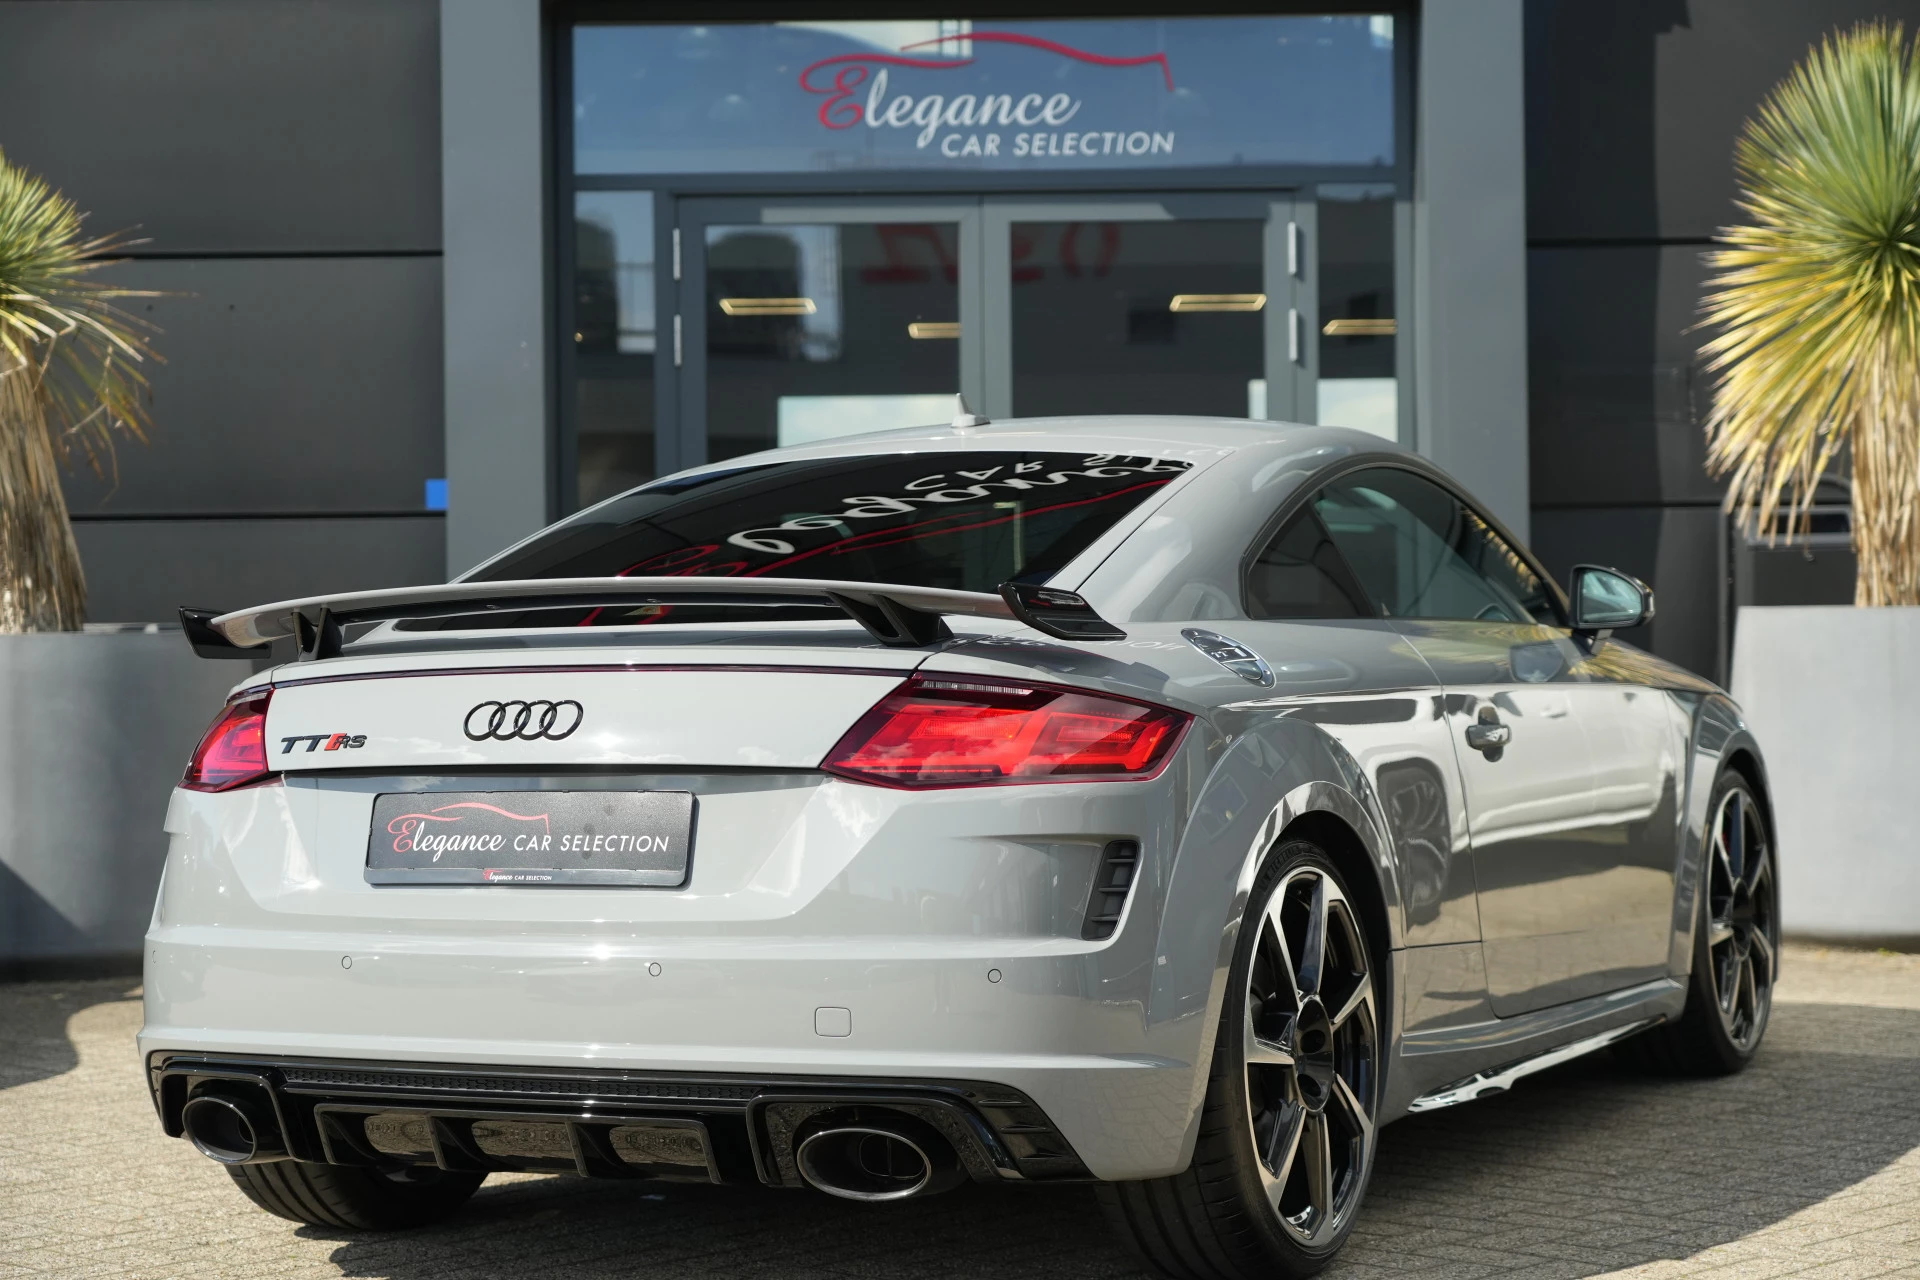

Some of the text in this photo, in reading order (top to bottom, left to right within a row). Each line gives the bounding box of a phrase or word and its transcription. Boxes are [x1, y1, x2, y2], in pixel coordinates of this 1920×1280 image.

[800, 54, 1082, 148] Elegance
[941, 131, 1174, 157] CAR SELECTION
[387, 814, 669, 862] Elegance CAR SELECTION
[483, 869, 513, 883] Elegance
